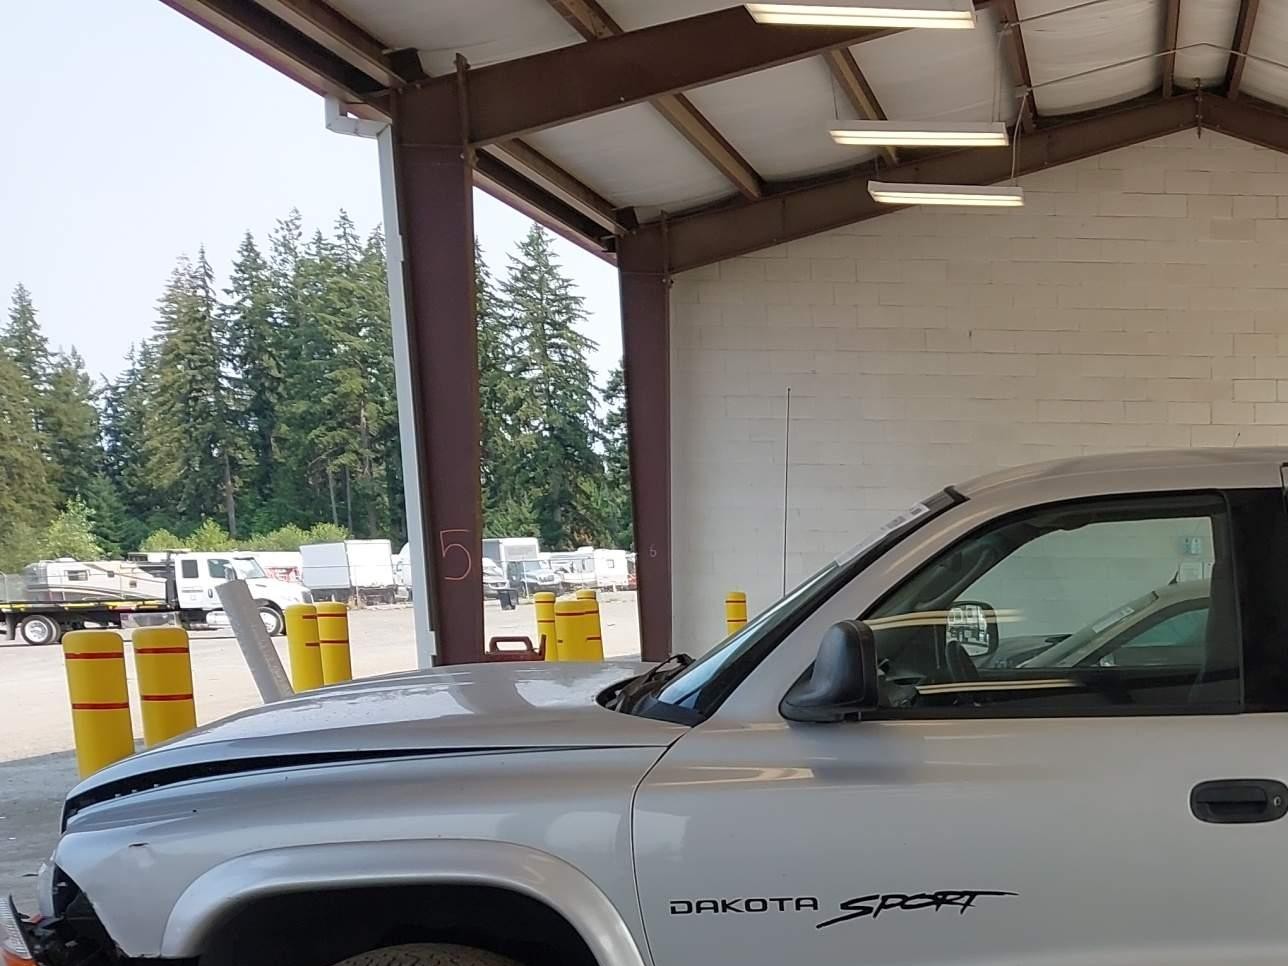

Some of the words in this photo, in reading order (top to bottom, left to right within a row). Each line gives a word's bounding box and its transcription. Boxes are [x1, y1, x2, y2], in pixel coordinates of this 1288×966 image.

[439, 528, 472, 581] 5
[670, 896, 818, 915] DAKOTA
[815, 890, 1020, 929] SPORT
